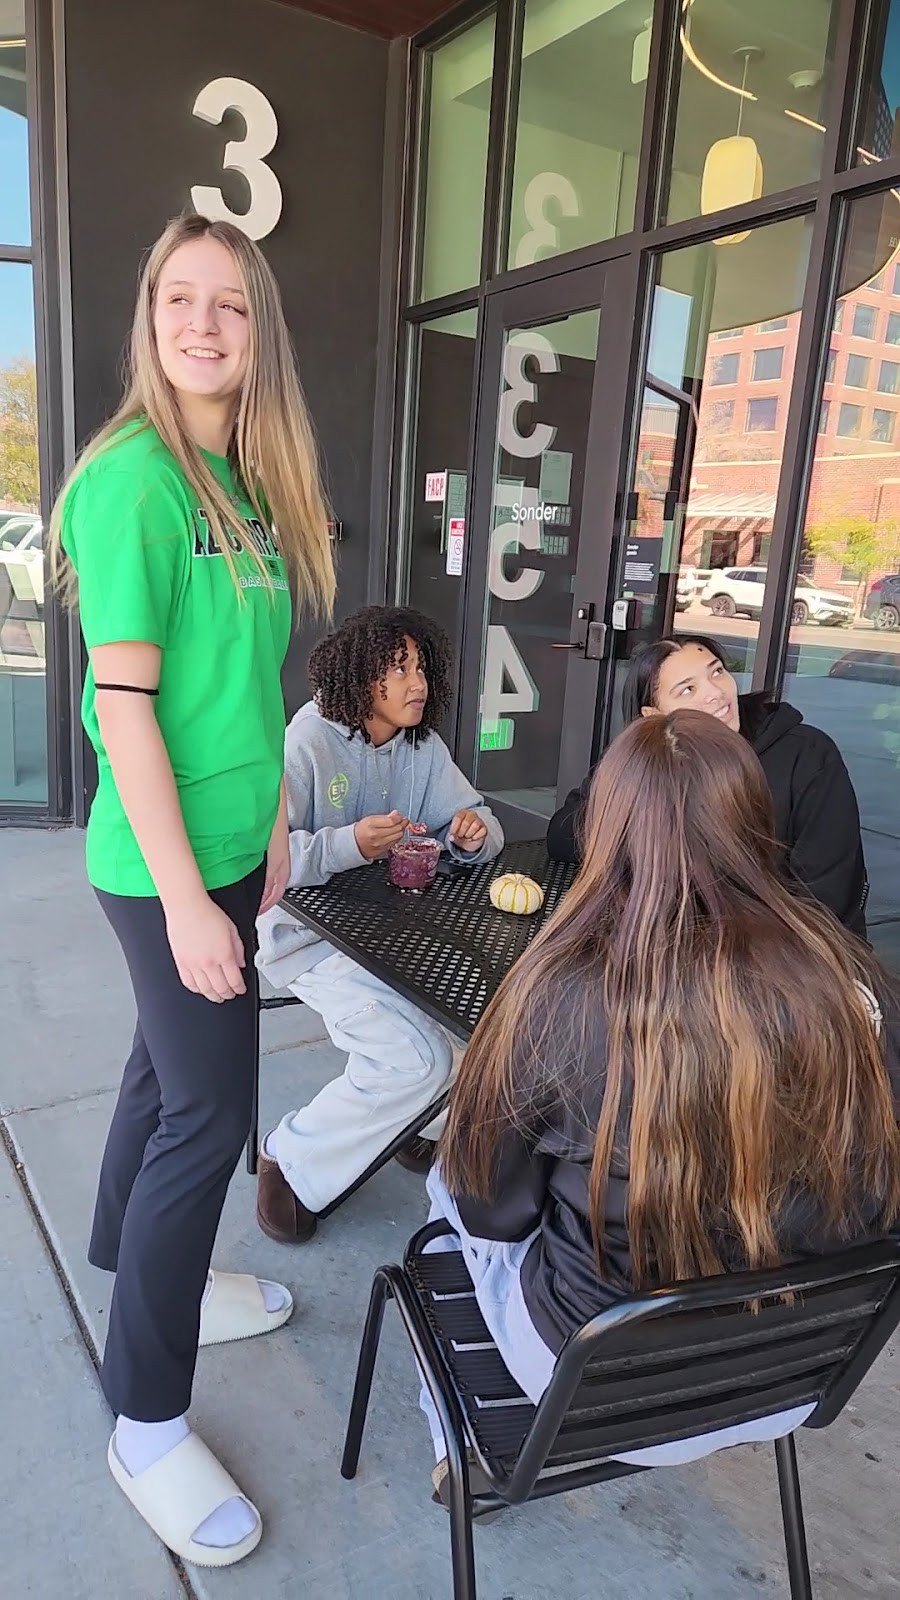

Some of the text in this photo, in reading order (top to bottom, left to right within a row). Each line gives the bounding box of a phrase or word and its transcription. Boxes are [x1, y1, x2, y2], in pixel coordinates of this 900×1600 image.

[190, 77, 282, 241] 3
[427, 478, 445, 497] FACP
[511, 502, 558, 521] Sonder
[239, 576, 289, 591] BASBALL
